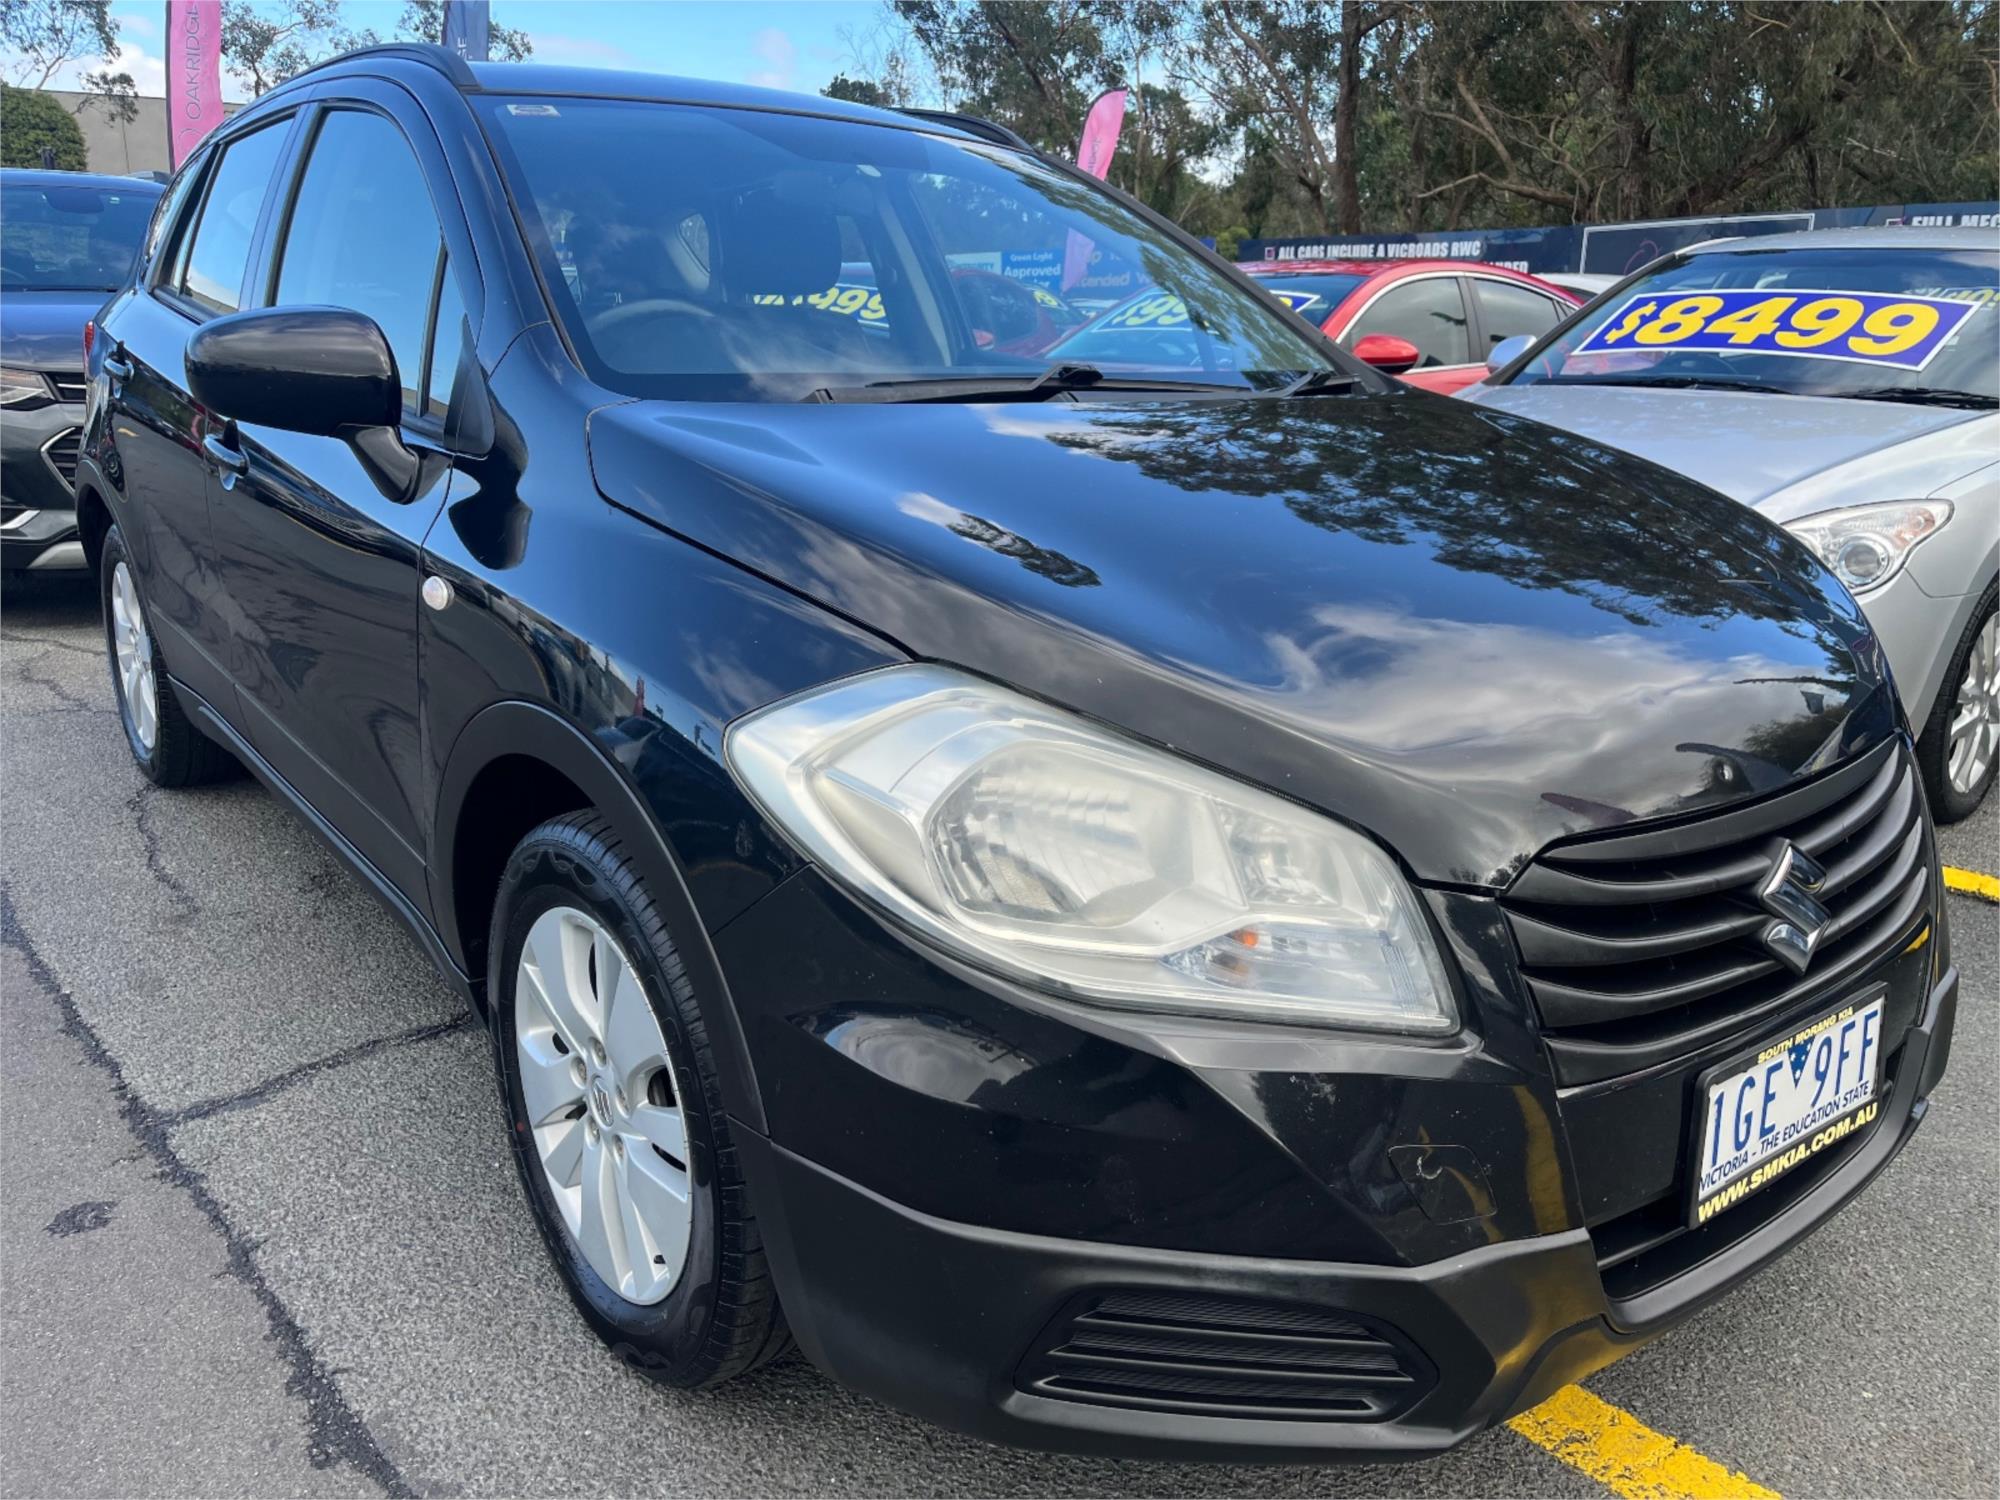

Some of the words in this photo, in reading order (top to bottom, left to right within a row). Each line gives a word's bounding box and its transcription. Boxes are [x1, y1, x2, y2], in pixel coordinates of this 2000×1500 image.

[1004, 263, 1061, 280] Approved
[1277, 246, 1295, 260] ALL
[1298, 244, 1325, 259] CARS
[1327, 243, 1373, 259] INCLUDE
[1376, 243, 1386, 258] A
[1387, 241, 1449, 259] VICROADS
[1451, 240, 1481, 257] RWC
[1604, 296, 1940, 356] $8499
[1757, 1040, 1793, 1064] SOUTH
[1794, 1015, 1836, 1045] MORANG
[1838, 1006, 1854, 1023] KIA
[1698, 1102, 1878, 1223] WWW.SMKIA.COM.AU
[1699, 1152, 1749, 1192] VICTORIA
[1760, 1133, 1781, 1154] THE
[1782, 1095, 1841, 1142] EDUCATION
[1842, 1080, 1870, 1108] STATE
